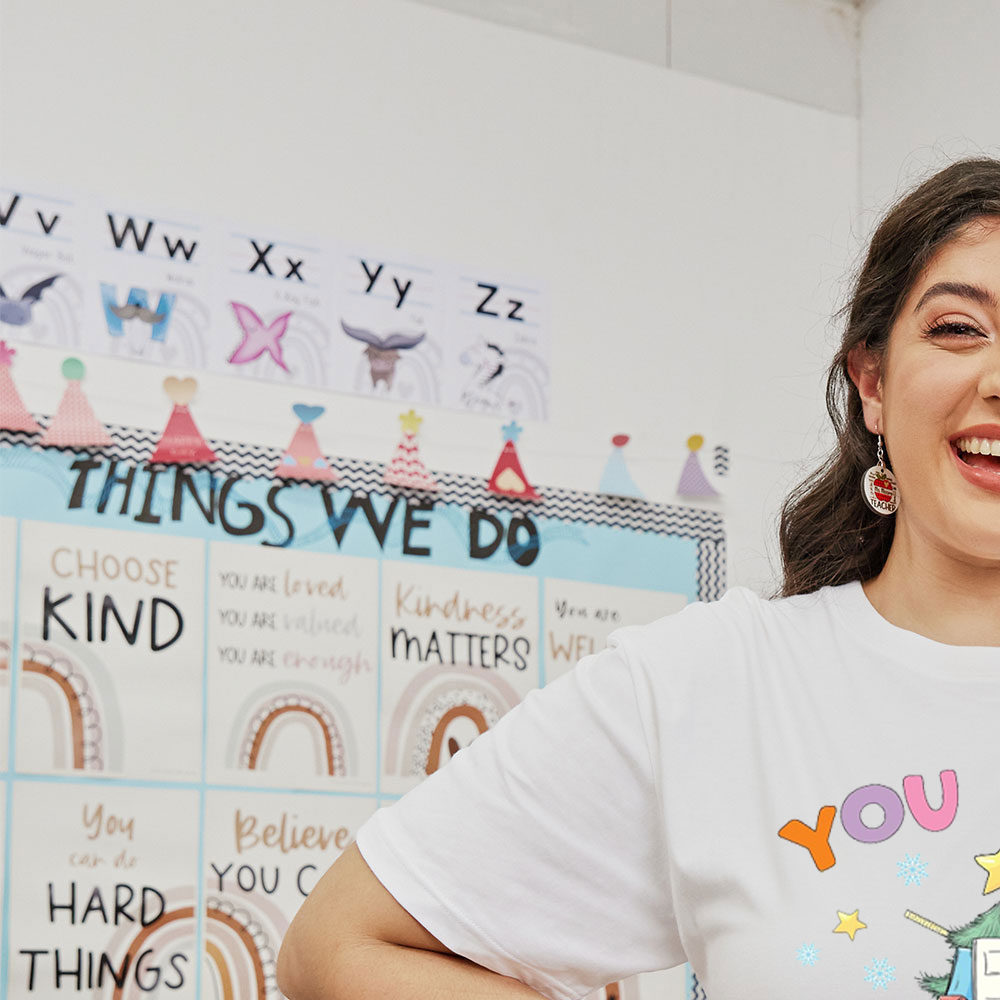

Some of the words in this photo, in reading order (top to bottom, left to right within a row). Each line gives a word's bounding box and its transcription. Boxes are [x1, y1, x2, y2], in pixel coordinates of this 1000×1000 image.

[68, 459, 295, 548] THINGS
[321, 486, 436, 557] WE
[469, 505, 541, 567] DO
[50, 547, 179, 590] CHOOSE
[219, 571, 248, 590] YOU
[252, 574, 277, 593] ARE
[283, 568, 347, 601] loved
[43, 586, 184, 651] KIND
[218, 608, 247, 628] YOU
[252, 610, 277, 630] ARE
[283, 607, 363, 639] valued
[395, 580, 526, 631] Kindness
[555, 599, 588, 620] You
[218, 645, 247, 665] YOU
[251, 649, 276, 668] ARE
[283, 650, 372, 685] enough
[390, 624, 531, 672] MATTERS
[82, 803, 136, 840] You
[234, 808, 351, 854] Believe
[777, 768, 960, 872] YOU
[69, 853, 104, 869] can
[113, 849, 138, 869] do
[211, 862, 279, 894] YOU
[47, 881, 166, 928] HARD
[19, 948, 189, 992] THINGS
